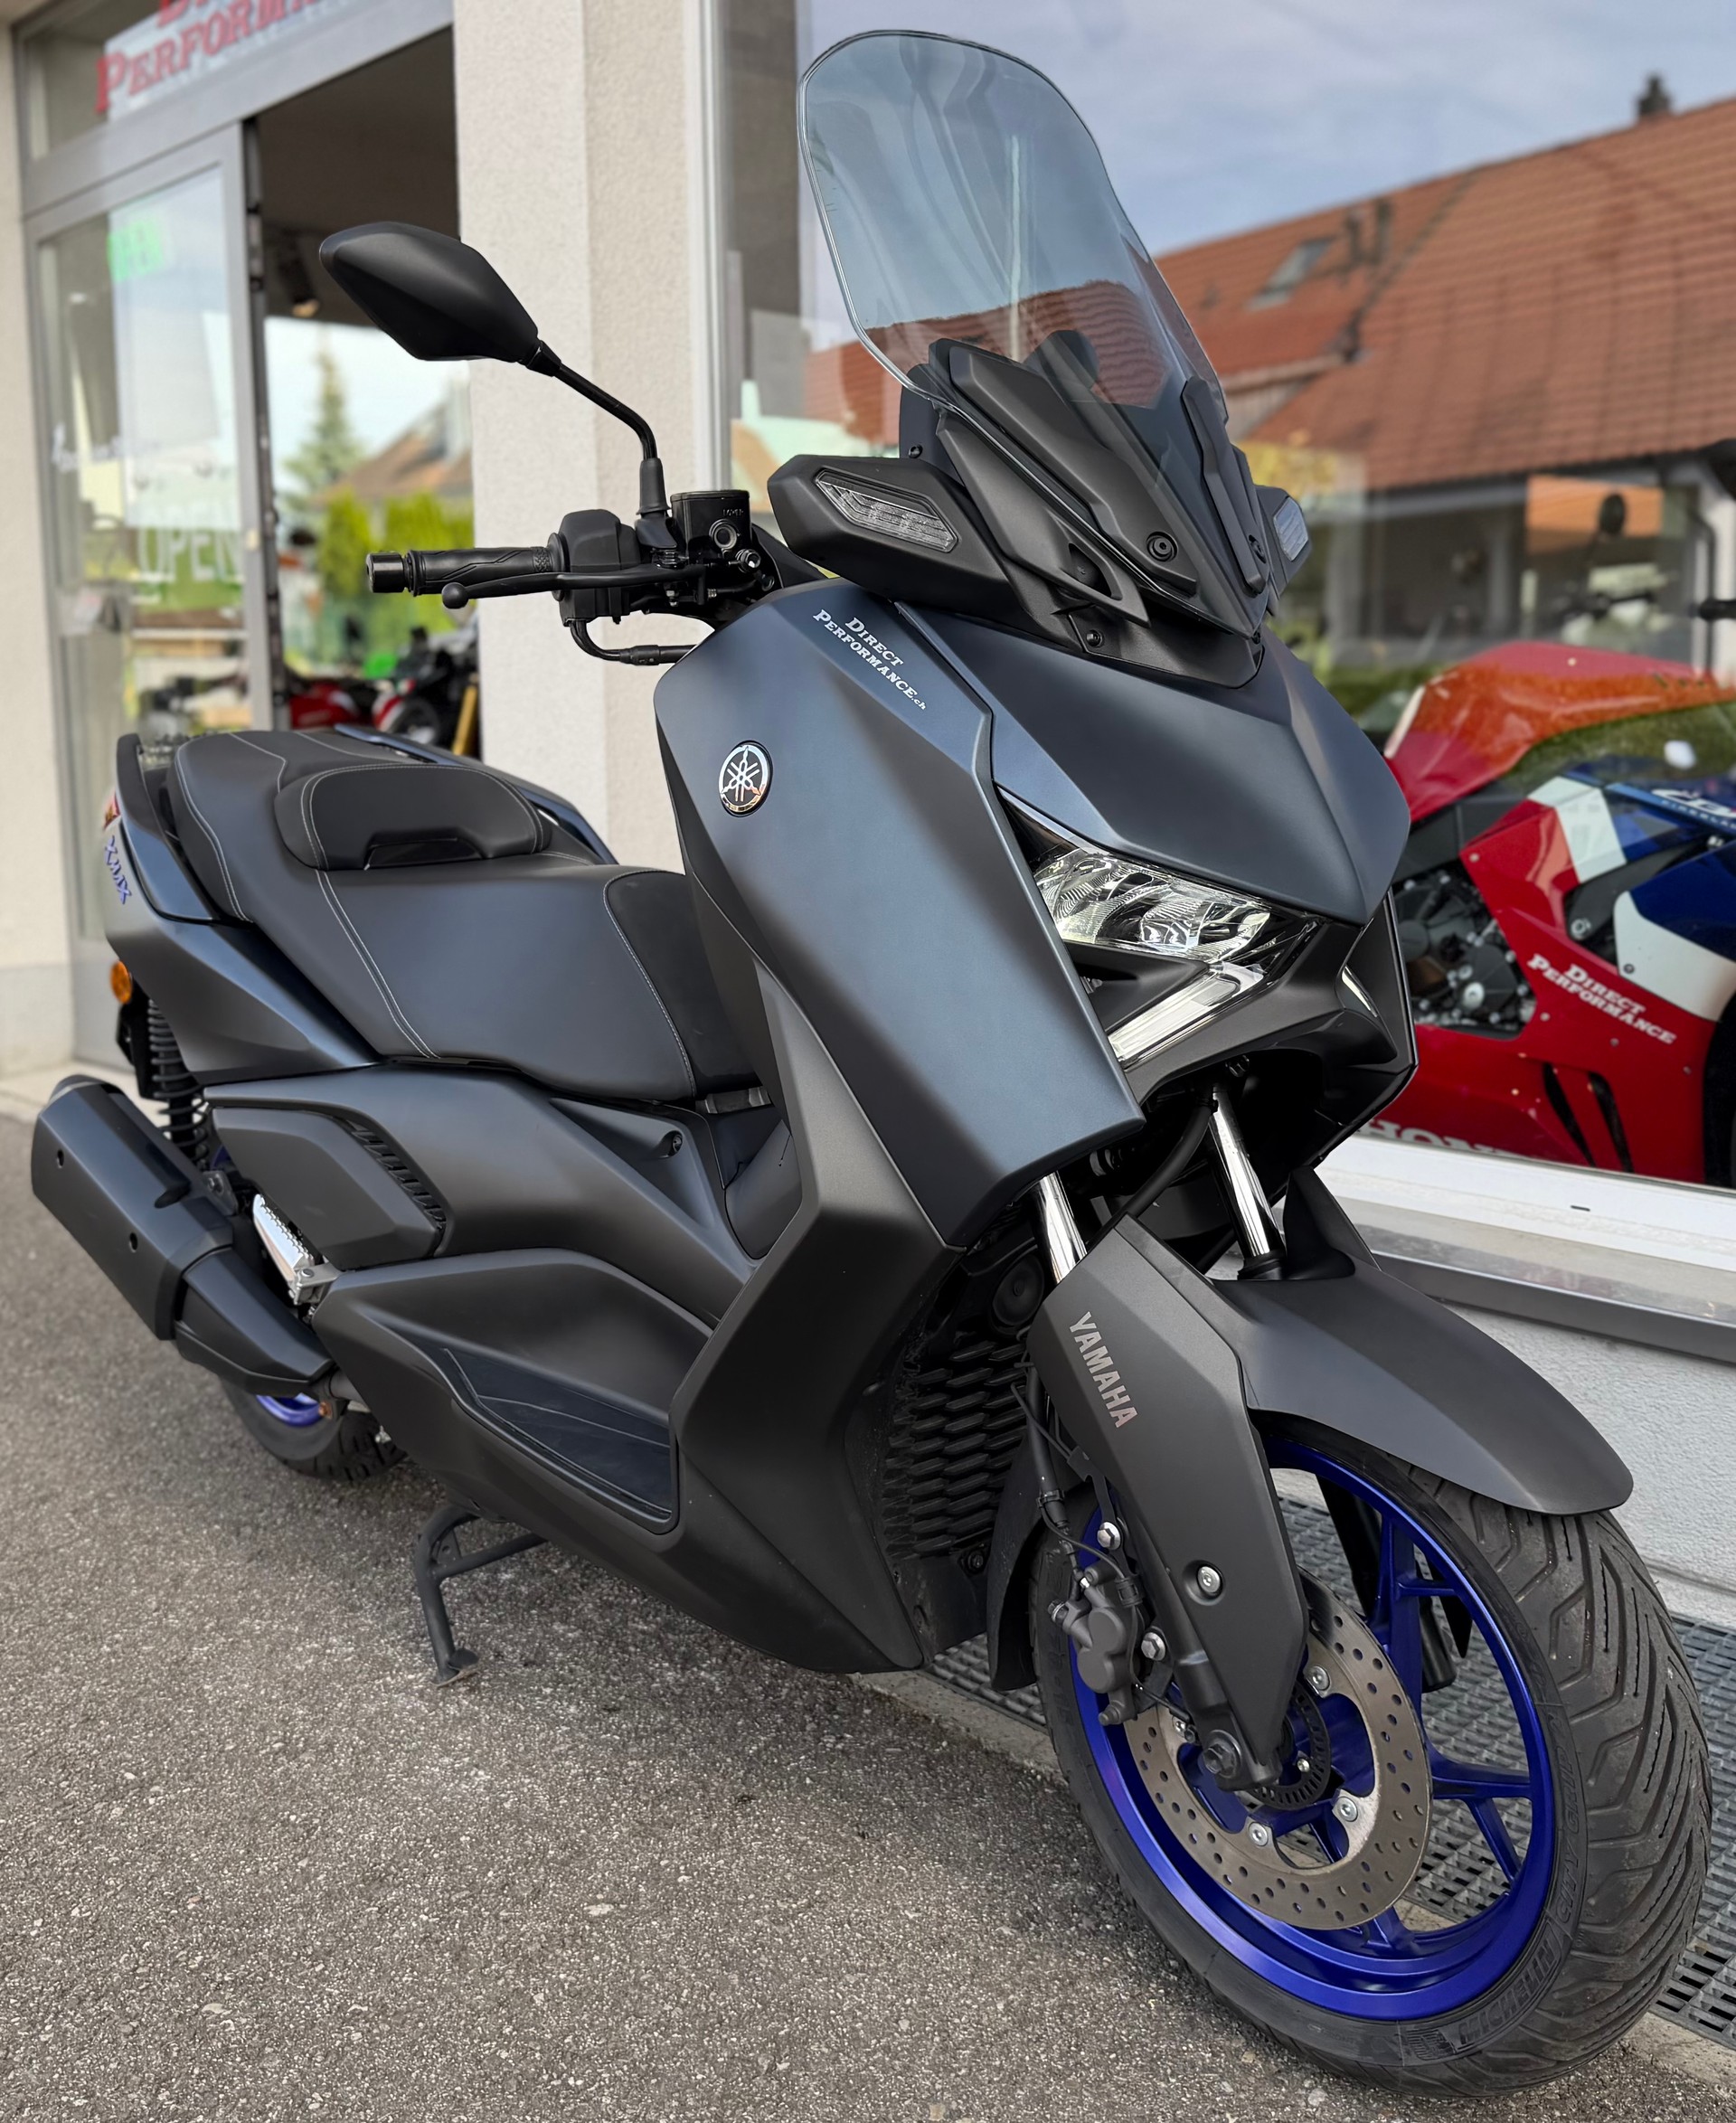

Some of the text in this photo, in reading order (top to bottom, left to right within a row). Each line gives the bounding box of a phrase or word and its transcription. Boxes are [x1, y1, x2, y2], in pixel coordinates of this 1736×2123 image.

[844, 617, 904, 666] DIRECT
[1526, 953, 1677, 1045] PERFORMANCE
[1564, 963, 1646, 1015] DIRECT
[1069, 1311, 1138, 1429] YAMAHA
[1458, 1938, 1556, 2045] MICHELIN
